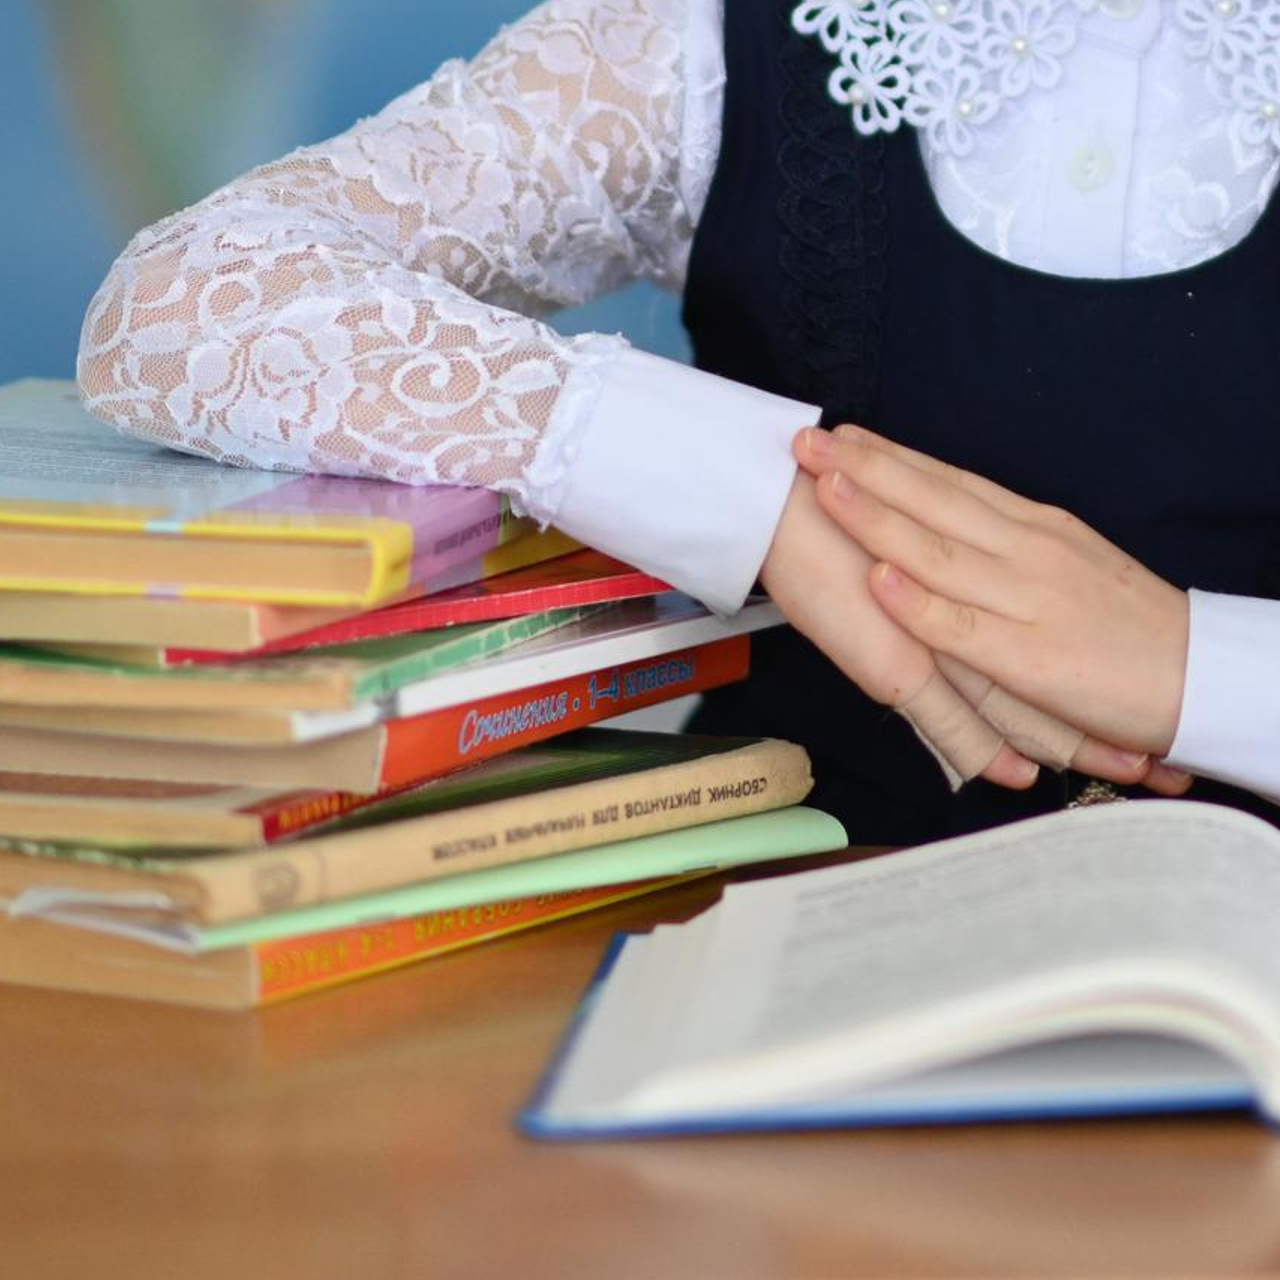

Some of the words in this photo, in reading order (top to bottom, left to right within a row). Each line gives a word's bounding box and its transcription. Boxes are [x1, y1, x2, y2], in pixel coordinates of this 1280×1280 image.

[459, 691, 568, 755] Сочинения
[624, 657, 694, 699] классы
[625, 788, 702, 819] ДИКТАНТОВ
[708, 776, 767, 803] СБОРНИК
